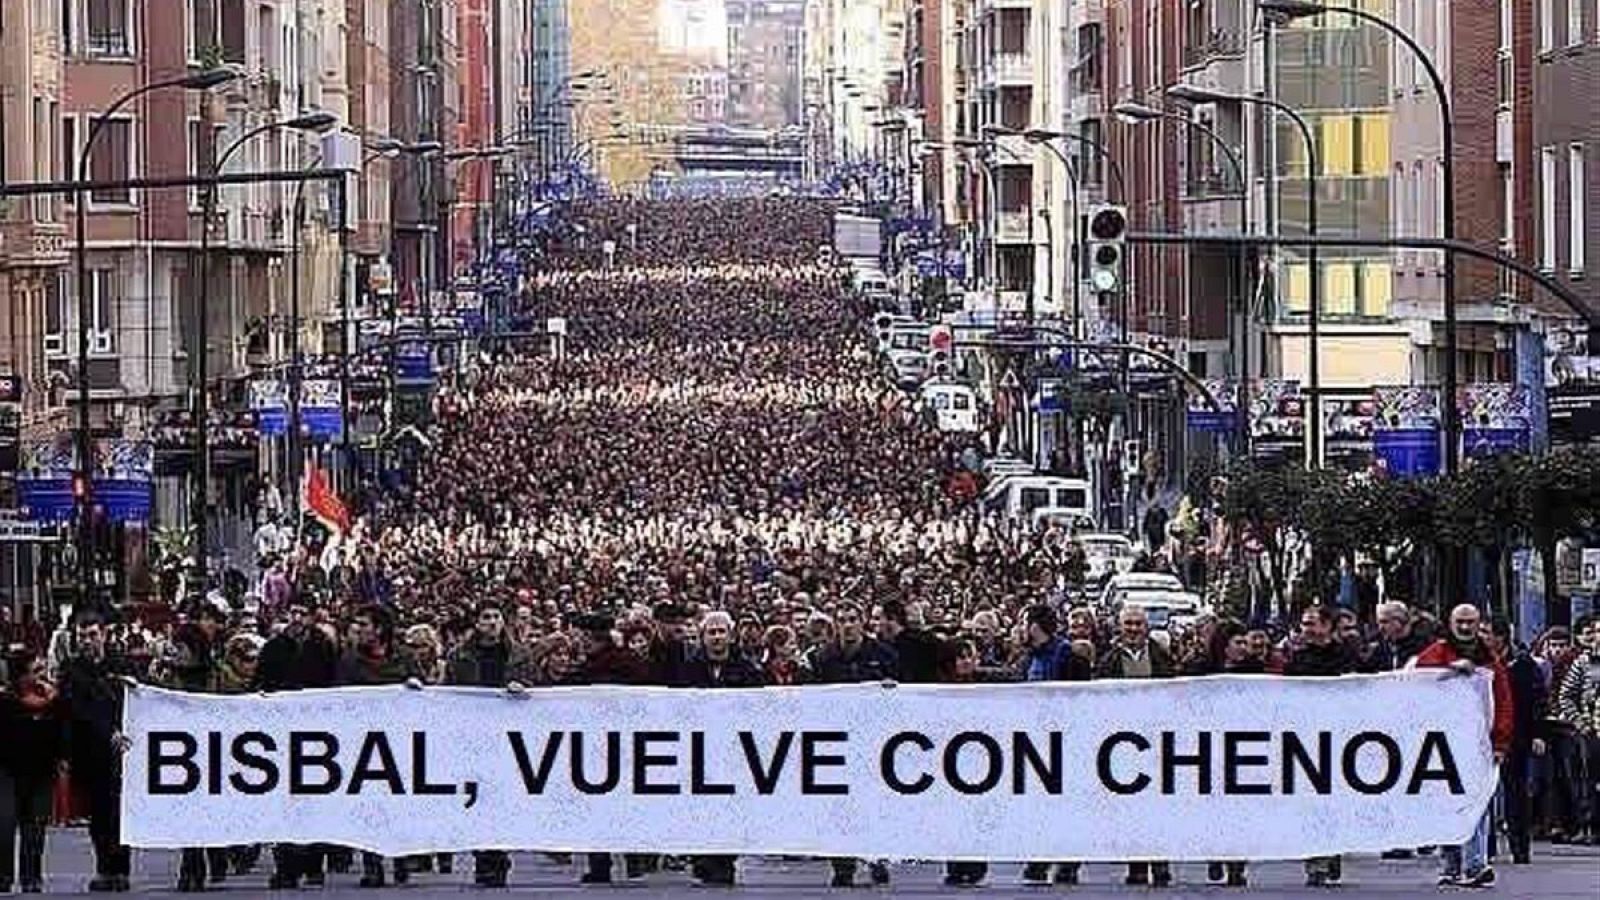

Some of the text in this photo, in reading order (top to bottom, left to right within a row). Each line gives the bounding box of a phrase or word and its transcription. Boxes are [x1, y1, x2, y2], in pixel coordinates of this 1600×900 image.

[147, 731, 1466, 809] BISBAL, VUELVE CON CHENOA
